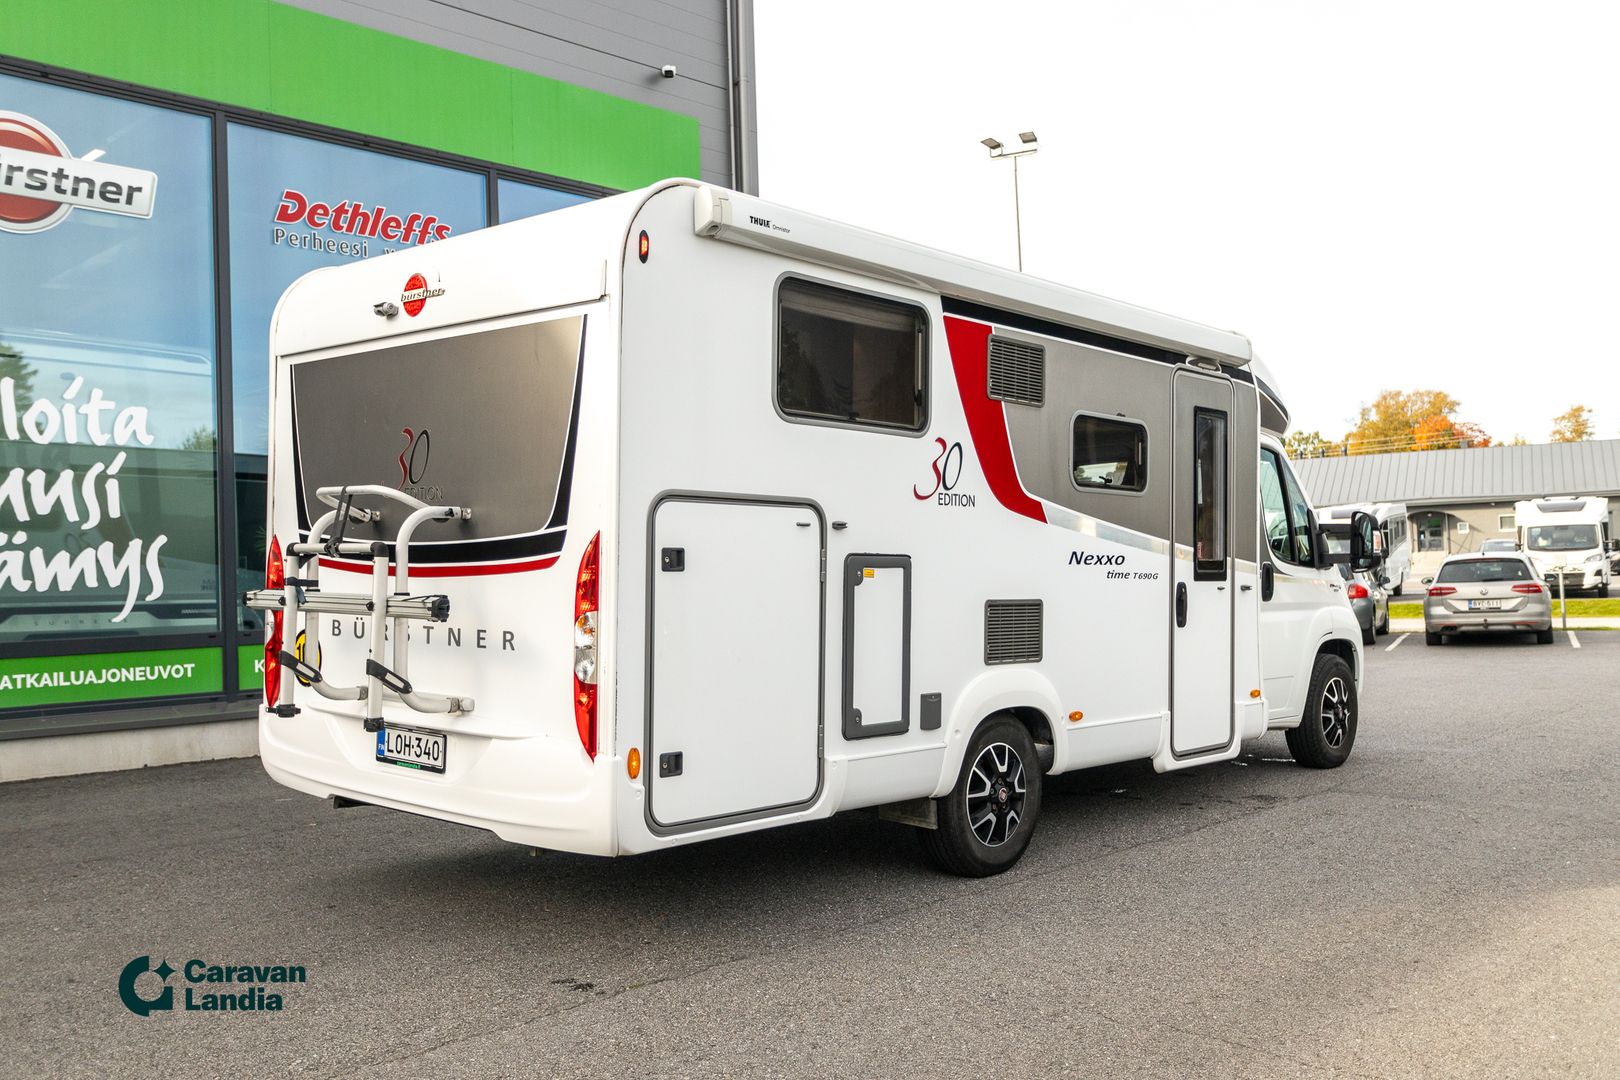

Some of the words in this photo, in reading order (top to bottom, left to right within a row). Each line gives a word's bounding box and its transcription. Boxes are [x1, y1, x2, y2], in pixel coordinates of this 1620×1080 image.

[0, 163, 143, 206] rstner
[275, 189, 452, 246] Dethleffs
[750, 215, 771, 229] THULE
[273, 227, 369, 257] Perheesi
[401, 287, 444, 302] bürstner
[913, 436, 963, 501] 30
[404, 486, 444, 501] EDITION
[938, 492, 976, 508] EDITION
[1068, 551, 1126, 566] Nexxo
[1106, 569, 1131, 579] time
[1133, 572, 1159, 580] T690G
[331, 616, 516, 651] BÜTNER
[387, 732, 440, 761] LOH-340
